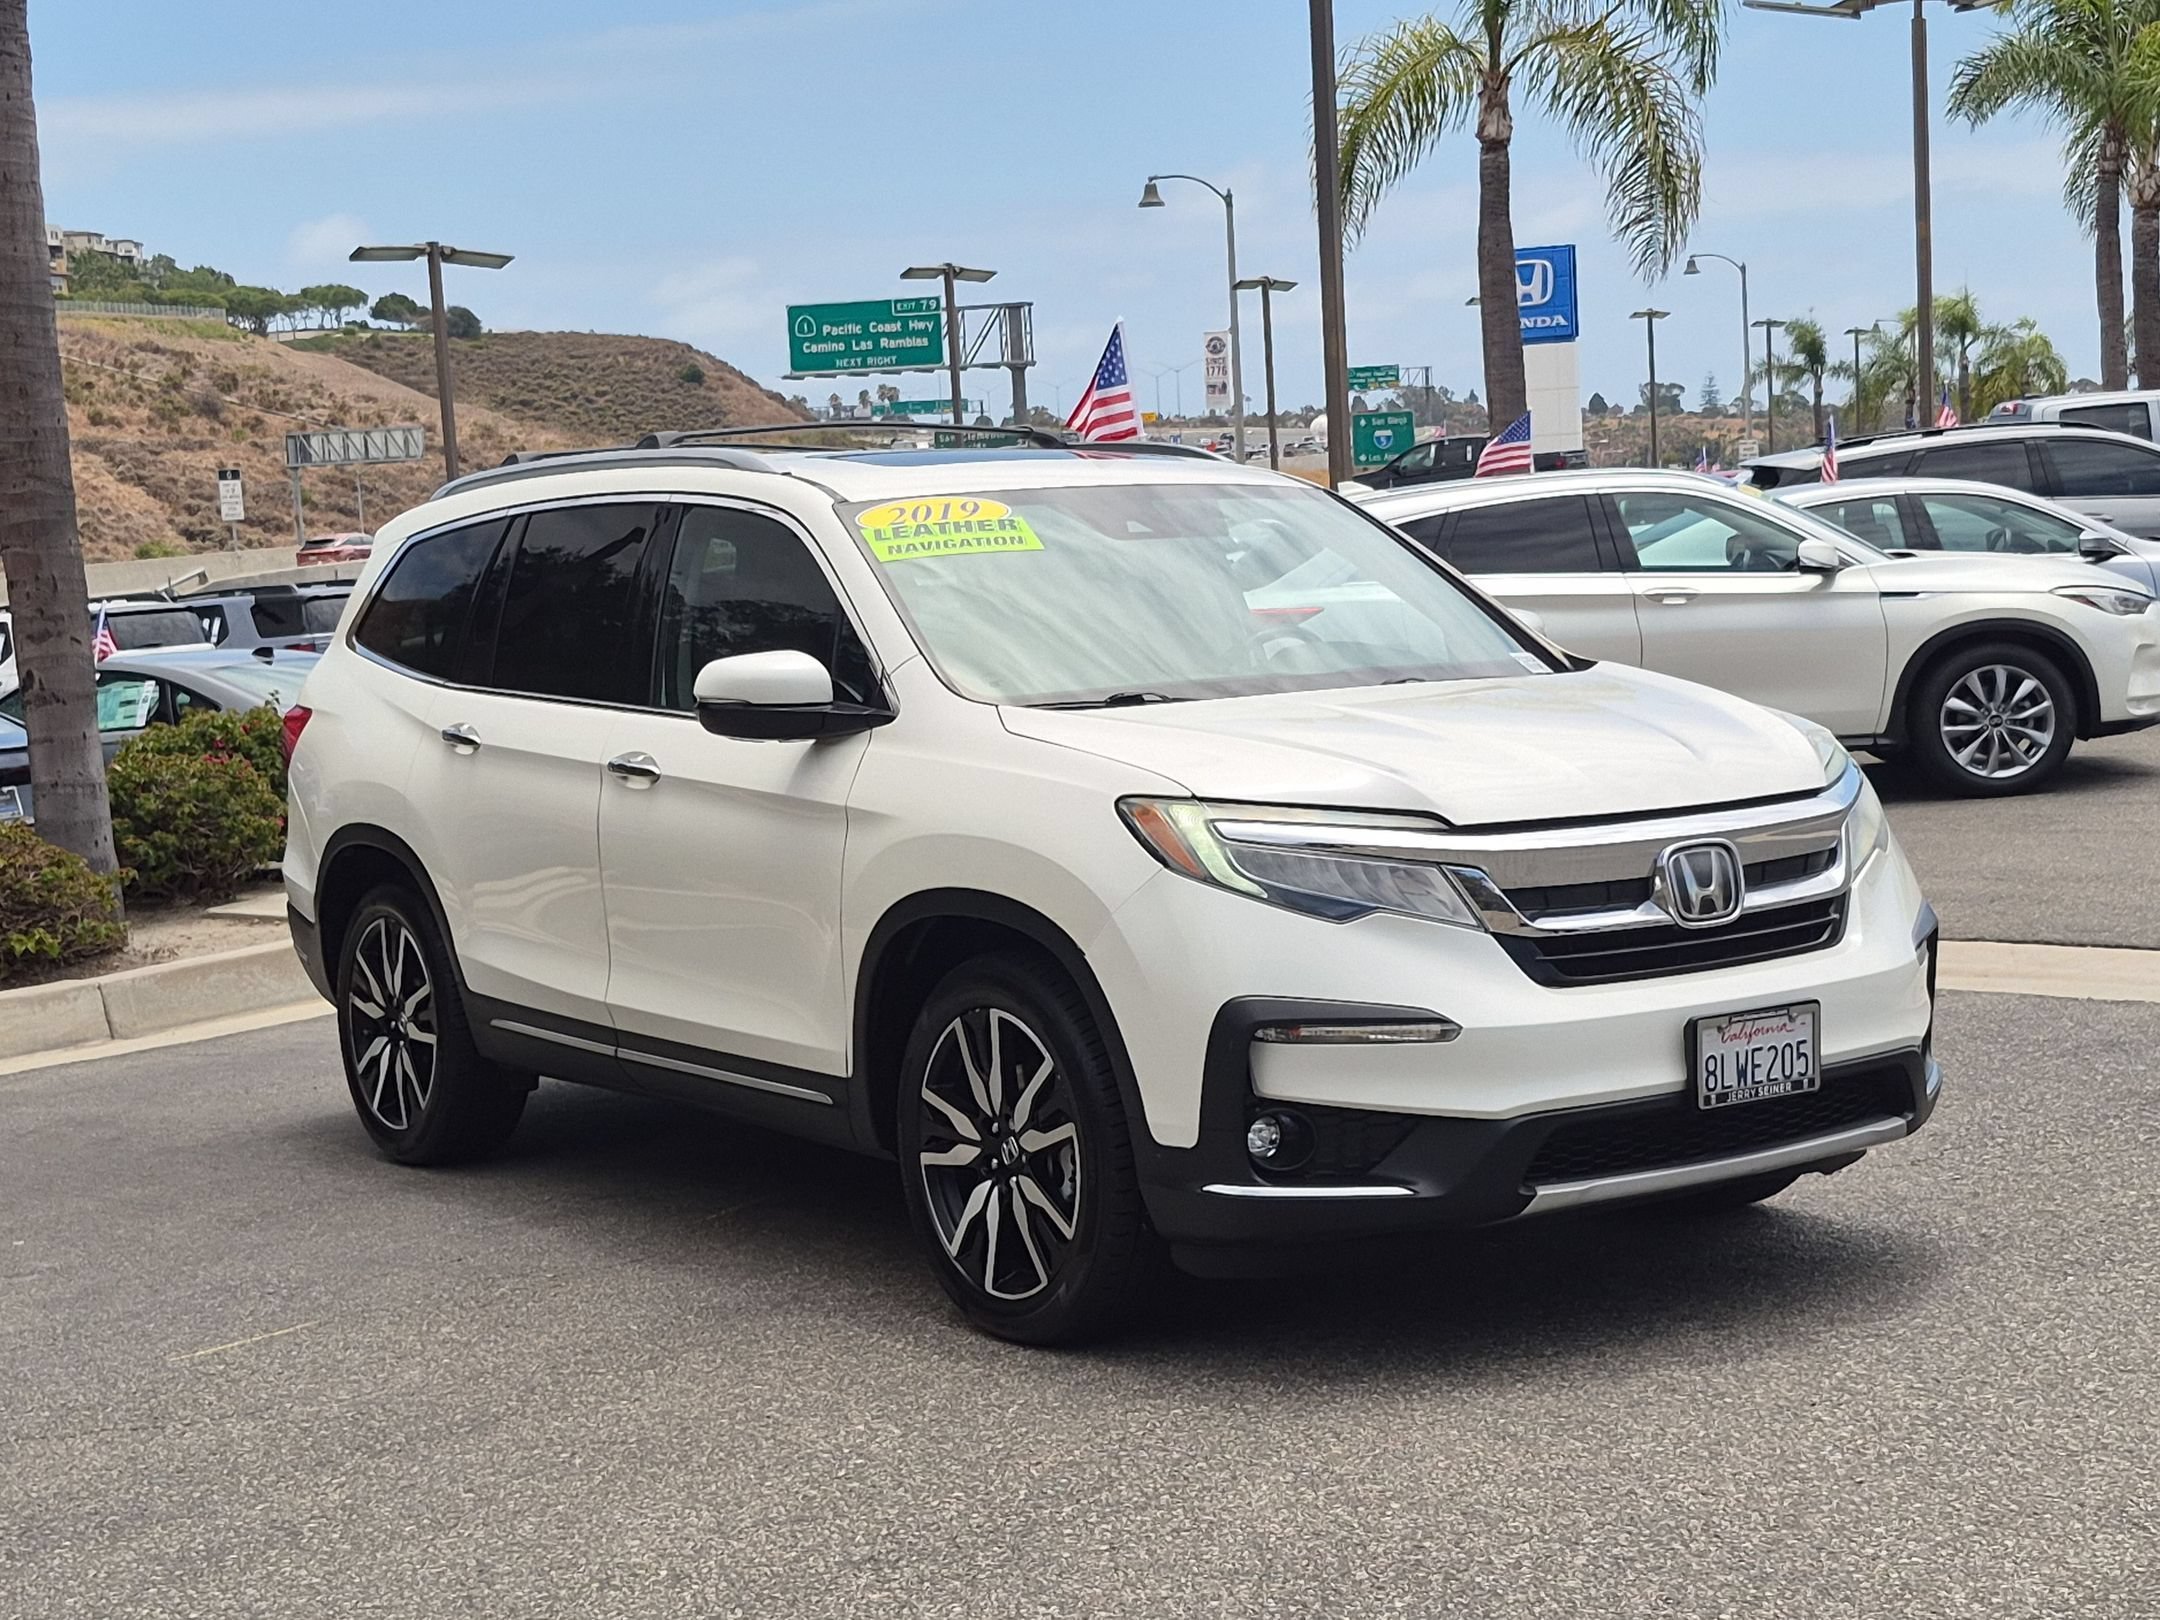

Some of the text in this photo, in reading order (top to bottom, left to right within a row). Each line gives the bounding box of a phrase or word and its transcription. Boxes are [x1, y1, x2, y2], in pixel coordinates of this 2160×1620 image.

[896, 300, 937, 311] EXIT 79
[822, 323, 862, 337] Pacific
[869, 321, 902, 334] Coast
[908, 319, 935, 333] Hwy
[1519, 314, 1569, 329] NDA
[802, 336, 929, 353] Camino Las Ramblas
[835, 355, 897, 368] NEXT RIGHT
[1206, 366, 1228, 377] 1776
[1380, 436, 1387, 446] 5
[886, 500, 980, 526] 2019
[873, 518, 1019, 542] LEATHER
[888, 535, 1025, 556] NAVIGATION
[1720, 1020, 1795, 1045] California
[1704, 1039, 1809, 1093] 8LWE205
[1727, 1082, 1792, 1102] JERRY SEINER
